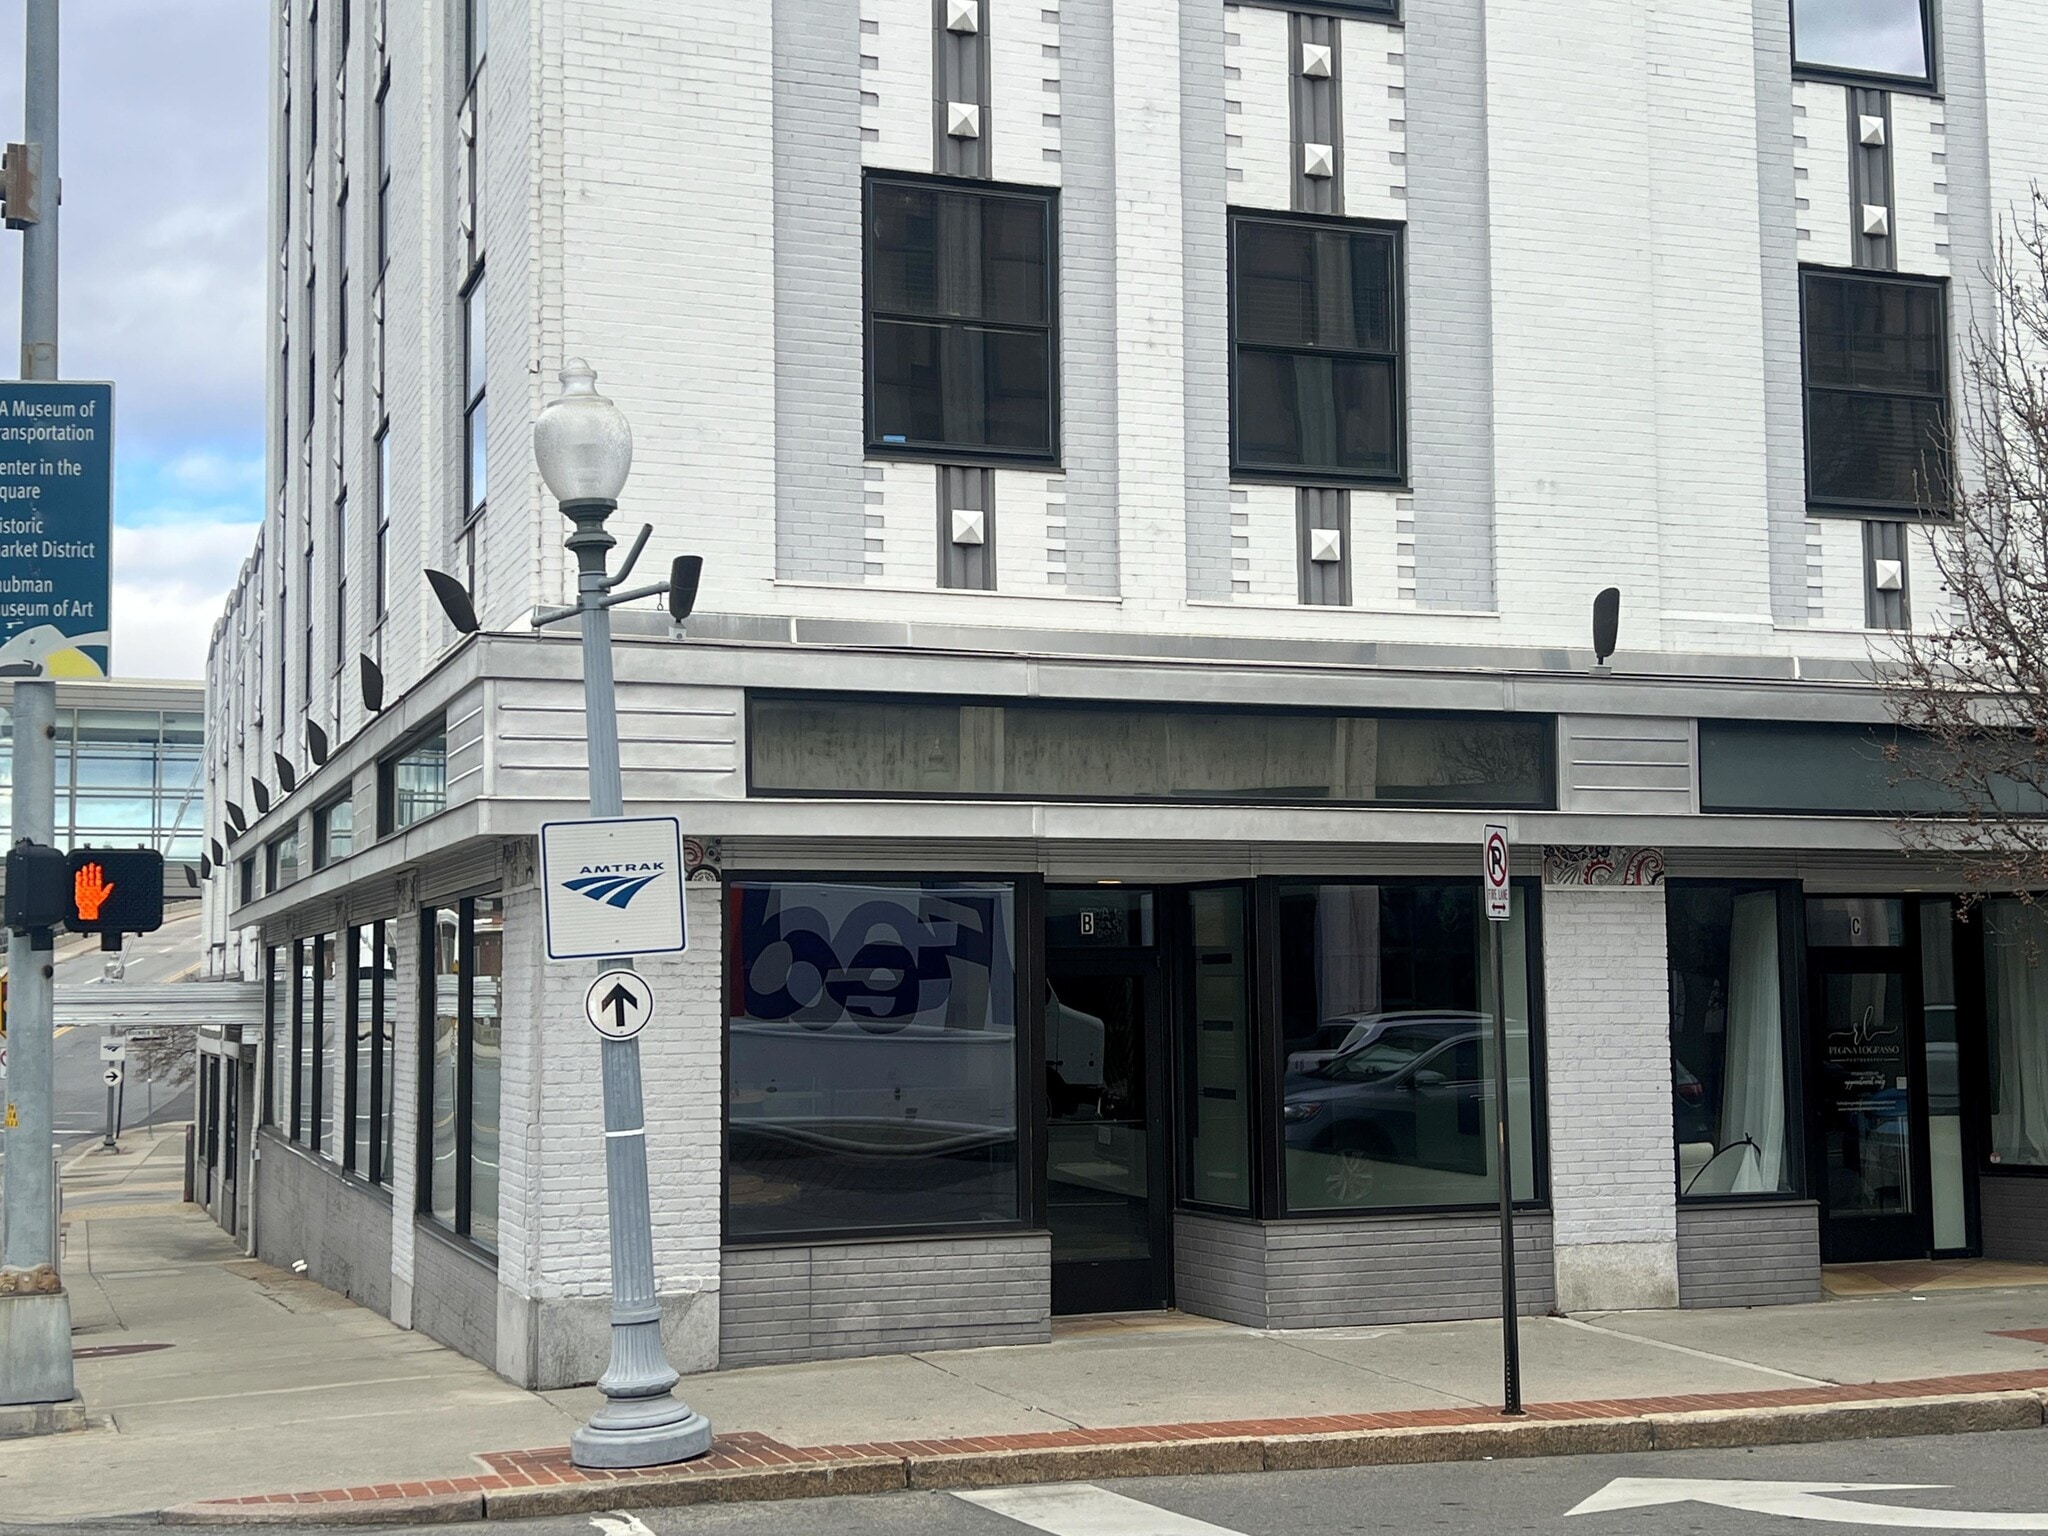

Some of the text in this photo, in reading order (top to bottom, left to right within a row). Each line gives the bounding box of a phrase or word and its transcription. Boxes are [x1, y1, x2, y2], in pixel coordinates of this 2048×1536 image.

[12, 400, 76, 417] Museum
[80, 400, 96, 417] of
[0, 458, 82, 476] enter in the
[0, 485, 41, 503] quare
[0, 516, 44, 534] istoric
[42, 540, 95, 558] District
[53, 599, 70, 617] of
[71, 600, 94, 617] Art
[579, 862, 665, 874] AMTRAK
[1082, 913, 1093, 934] B
[1852, 917, 1861, 935] C
